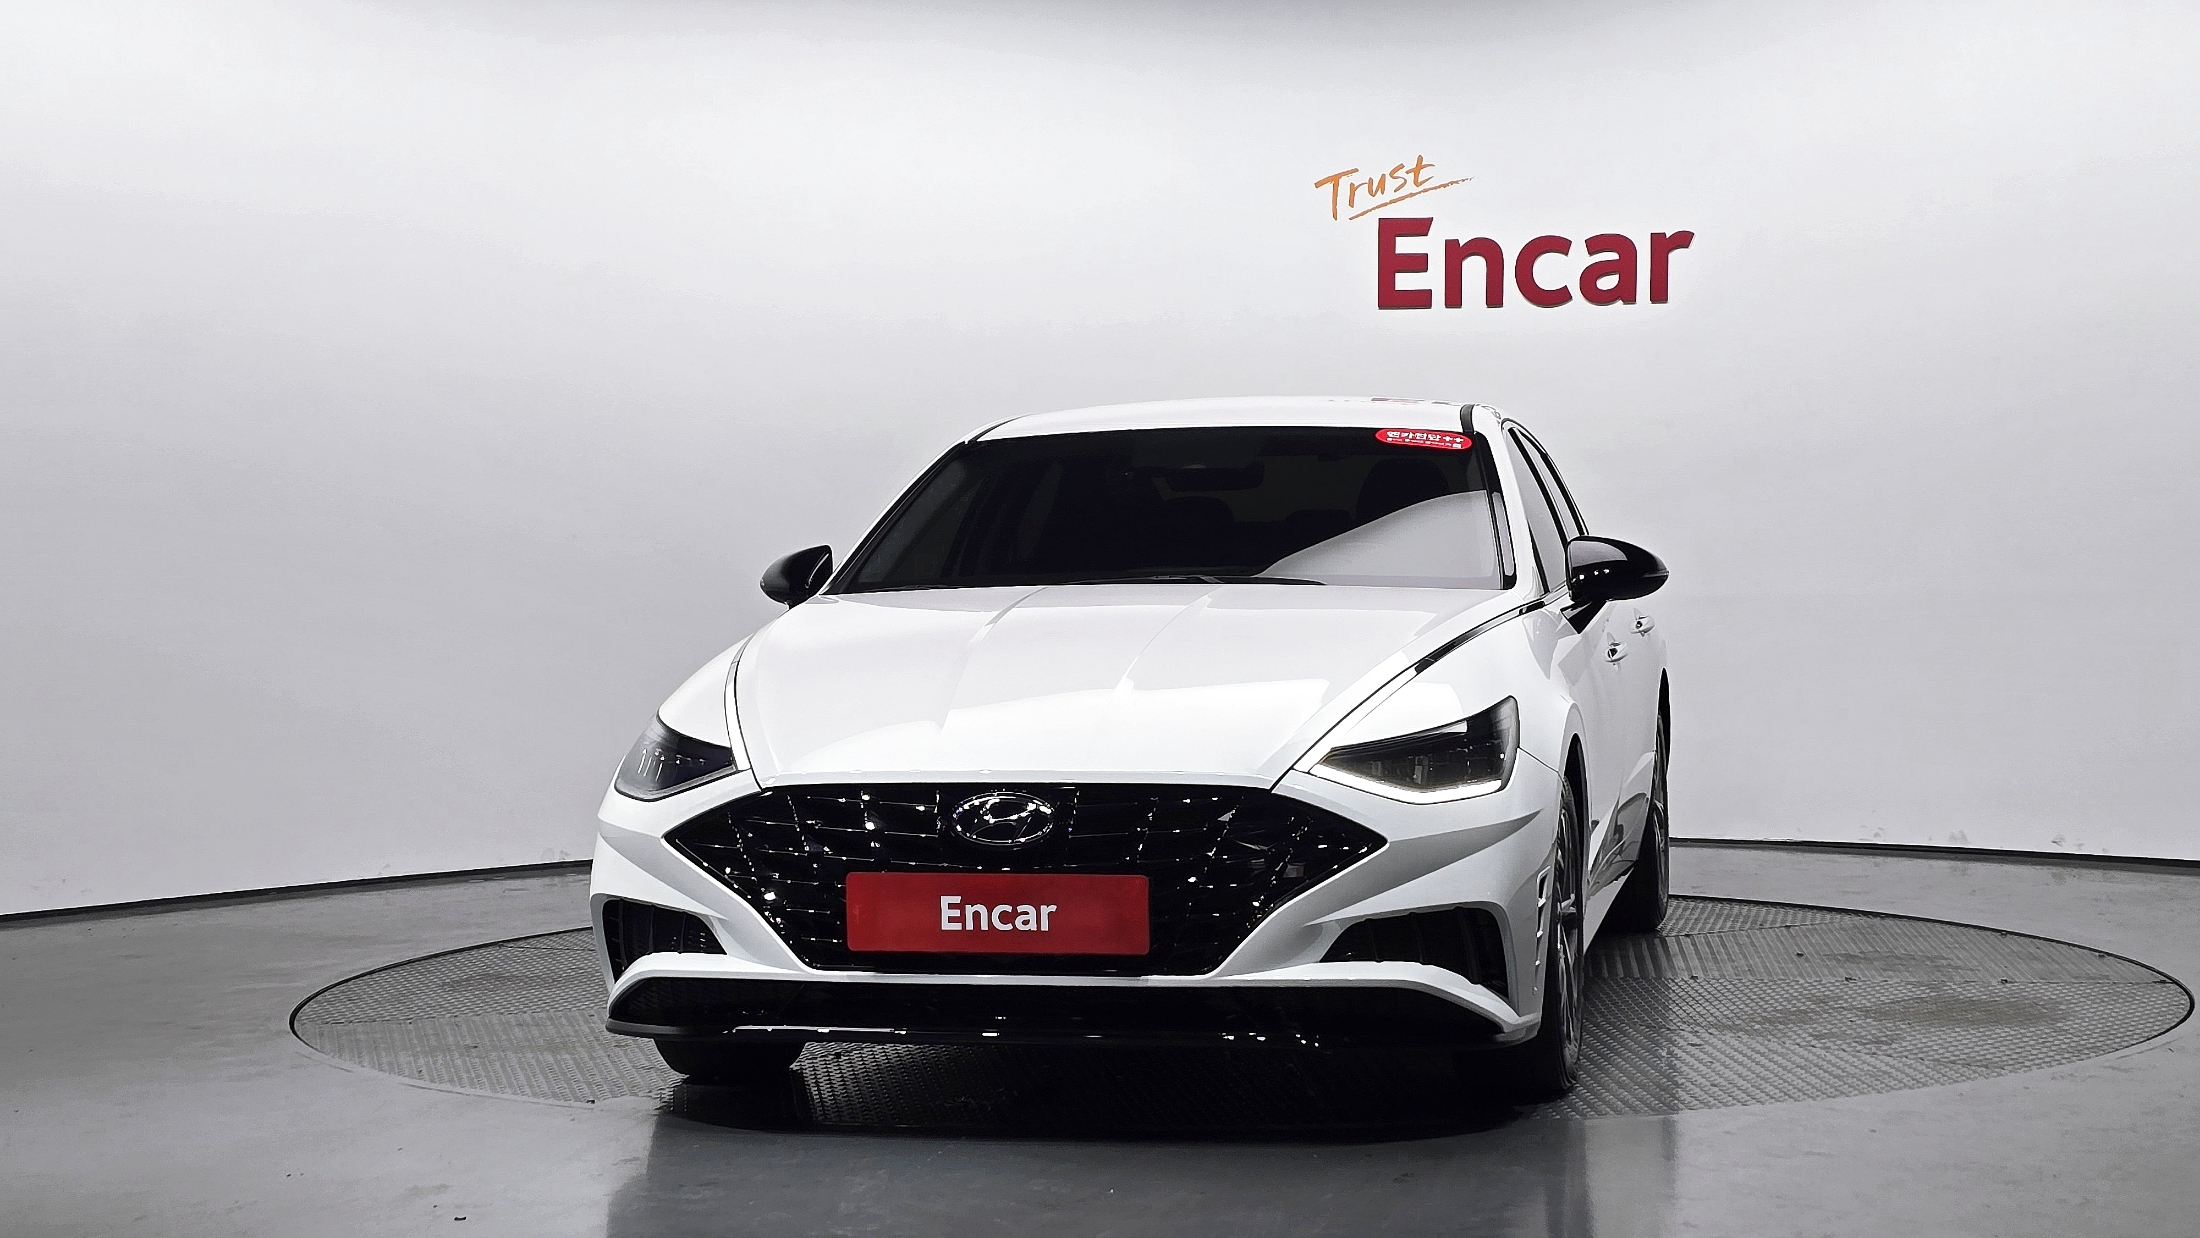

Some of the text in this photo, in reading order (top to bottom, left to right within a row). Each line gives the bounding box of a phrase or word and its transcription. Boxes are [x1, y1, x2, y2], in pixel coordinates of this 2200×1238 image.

[1314, 154, 1436, 221] Trust
[1377, 217, 1695, 310] Encar
[940, 895, 1057, 932] Encar
